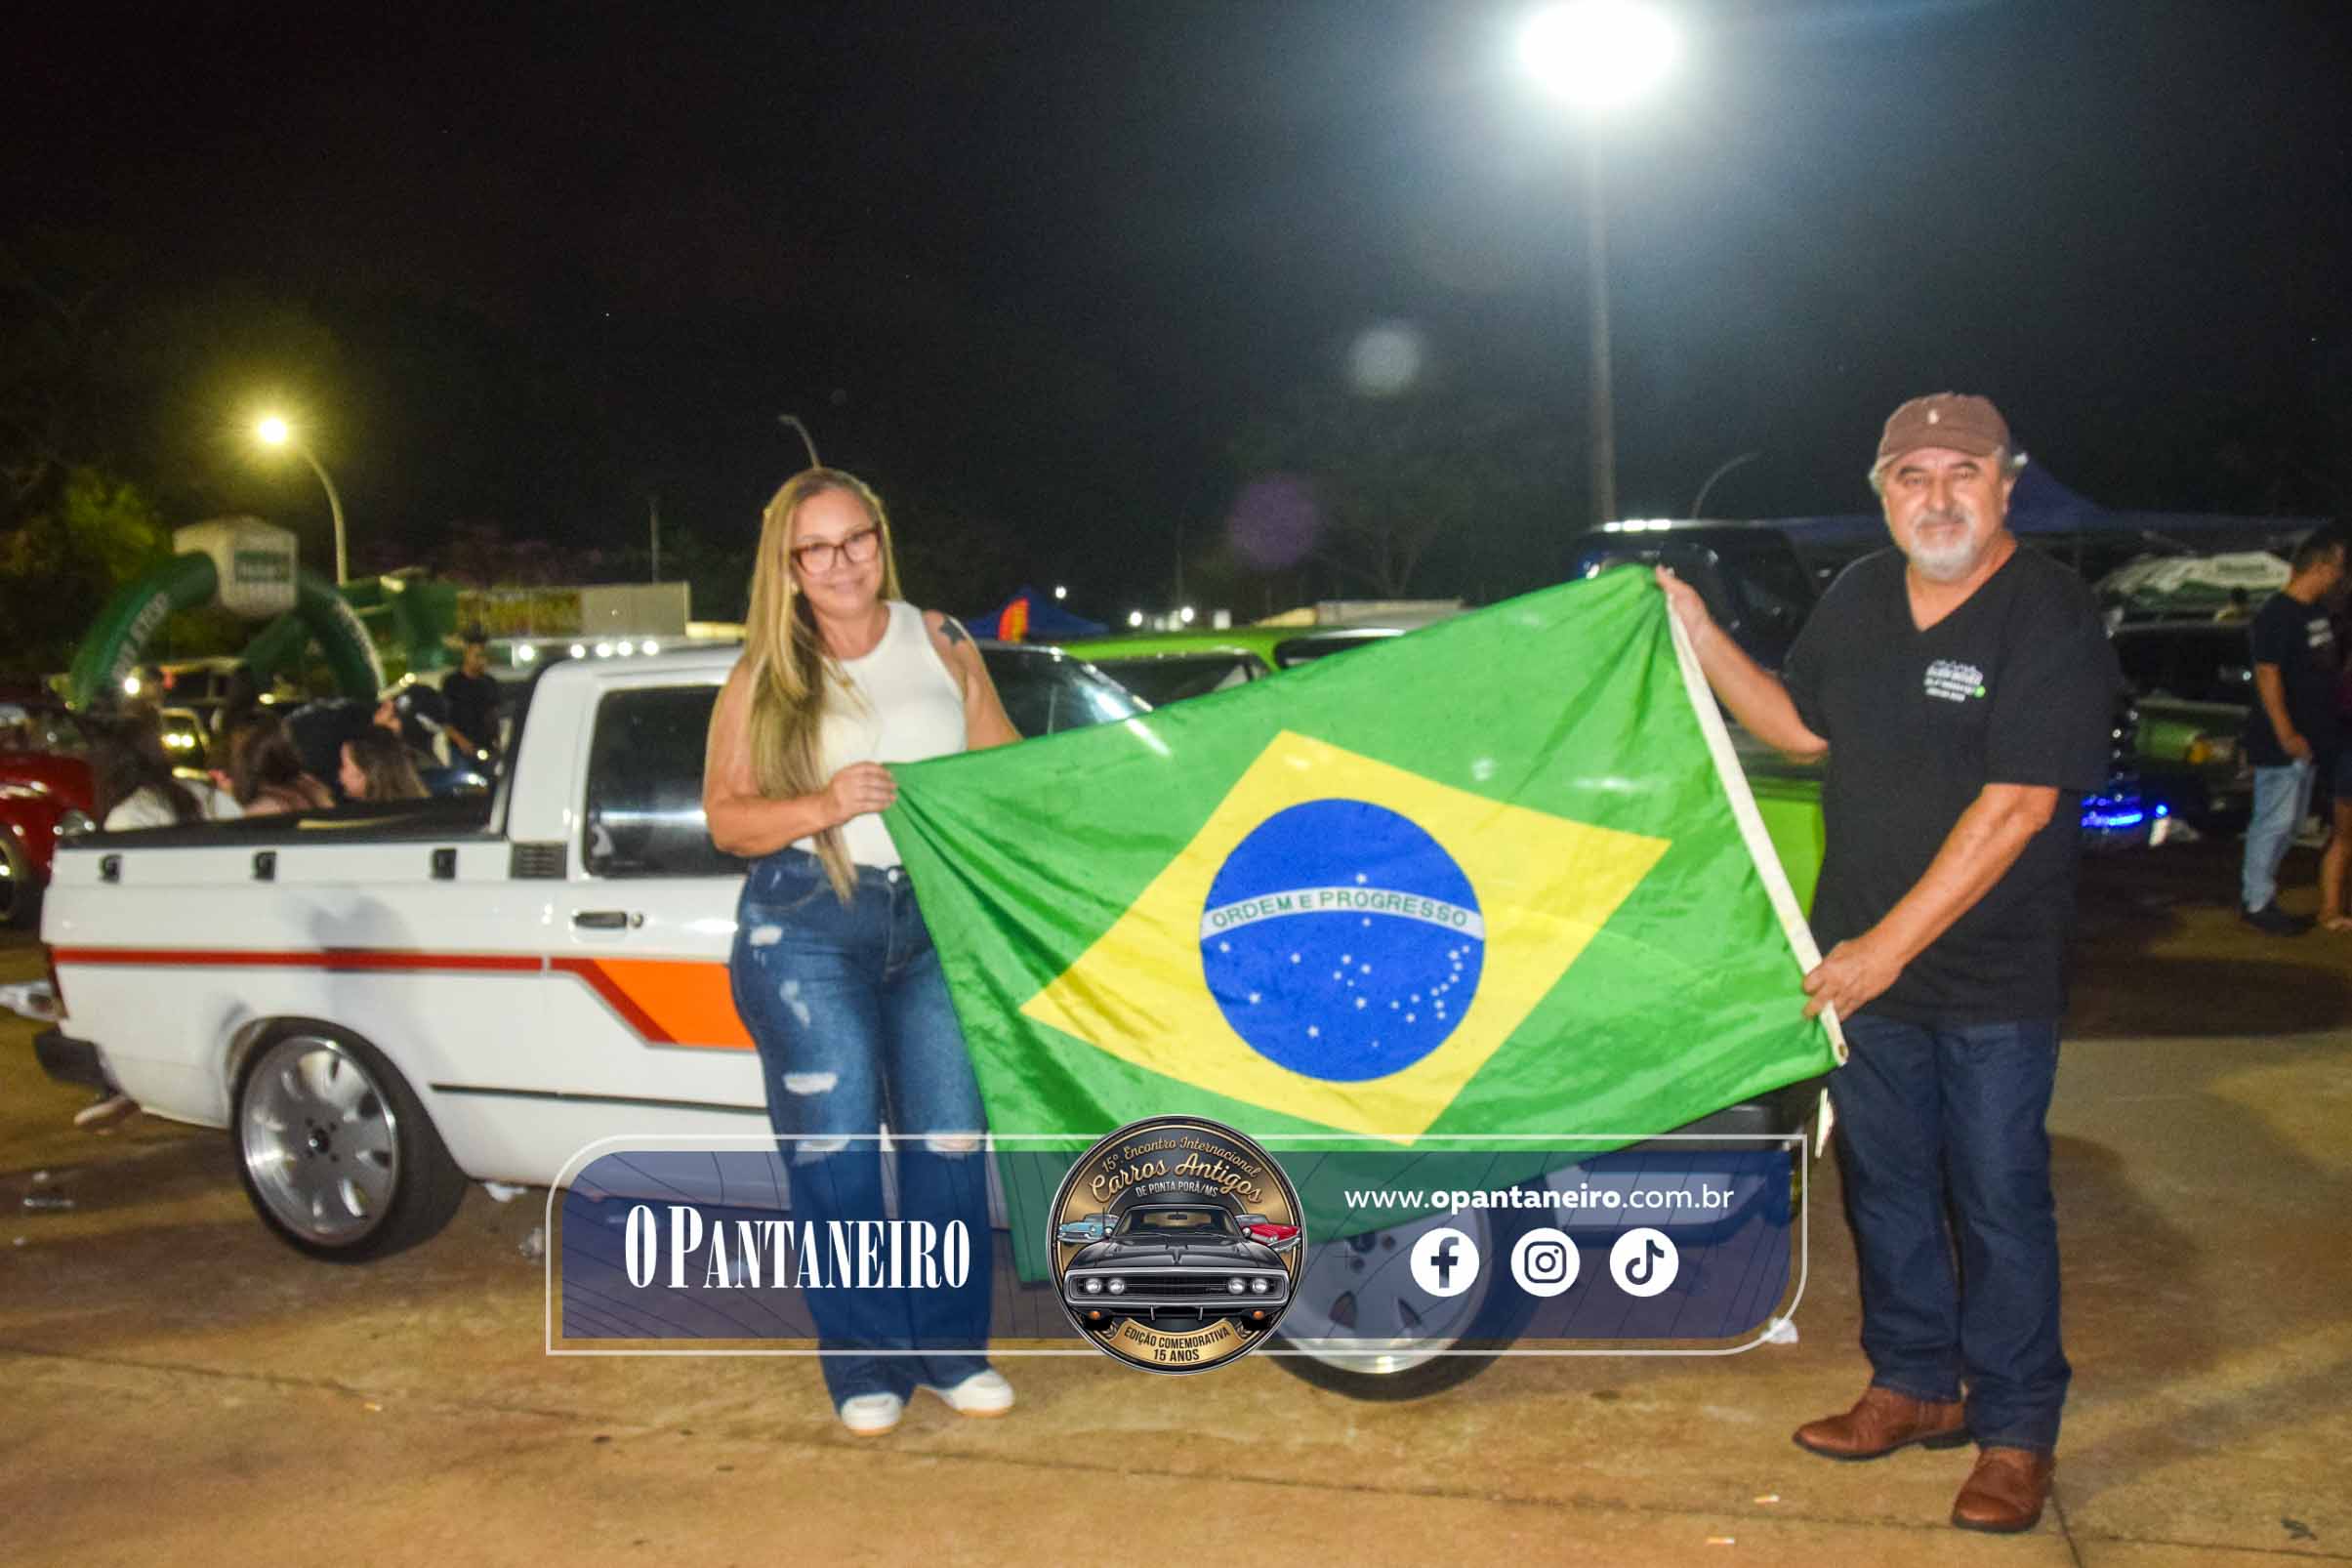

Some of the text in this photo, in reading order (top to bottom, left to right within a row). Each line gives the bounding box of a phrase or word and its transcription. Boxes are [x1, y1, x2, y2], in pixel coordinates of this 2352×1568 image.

[1211, 889, 1468, 928] ORDEM E PROGRESSO
